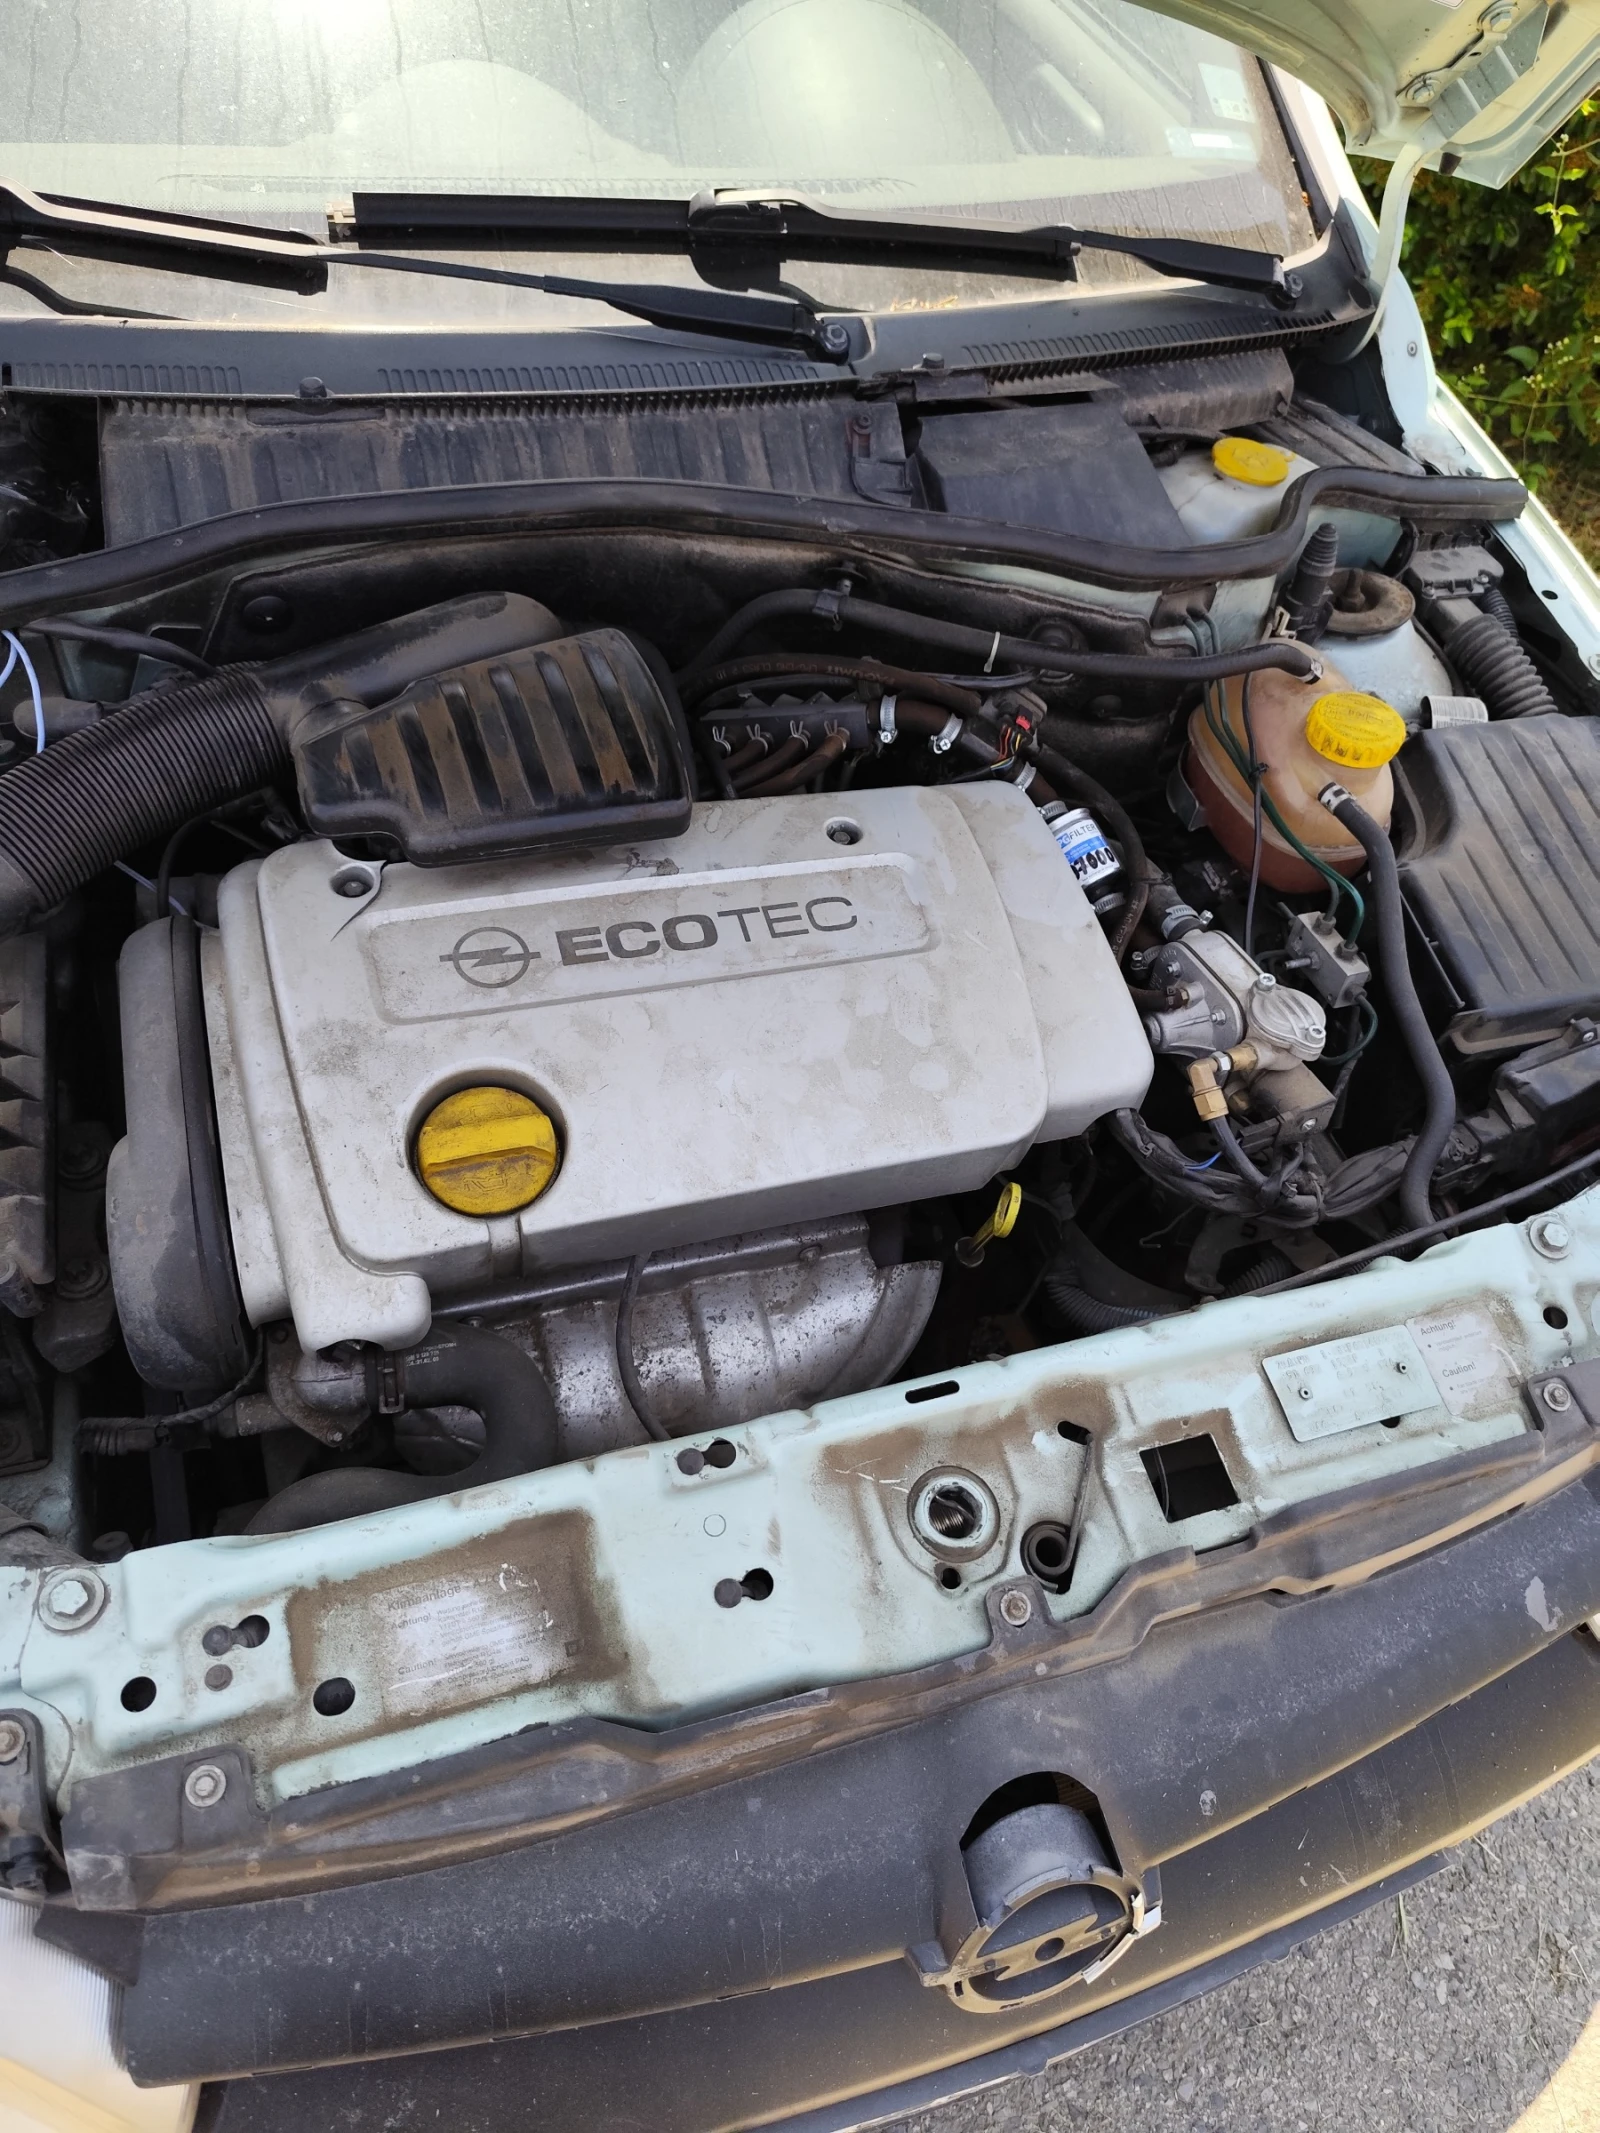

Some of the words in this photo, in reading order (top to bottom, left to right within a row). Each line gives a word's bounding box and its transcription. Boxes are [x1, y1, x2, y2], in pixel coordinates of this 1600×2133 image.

[555, 896, 858, 966] ECOTEC
[1420, 1320, 1456, 1336] Achtung!
[1442, 1361, 1476, 1377] Caution!
[387, 1584, 462, 1612] Klimaanlage
[390, 1612, 433, 1631] Achtung!
[398, 1658, 437, 1675] Caution!
